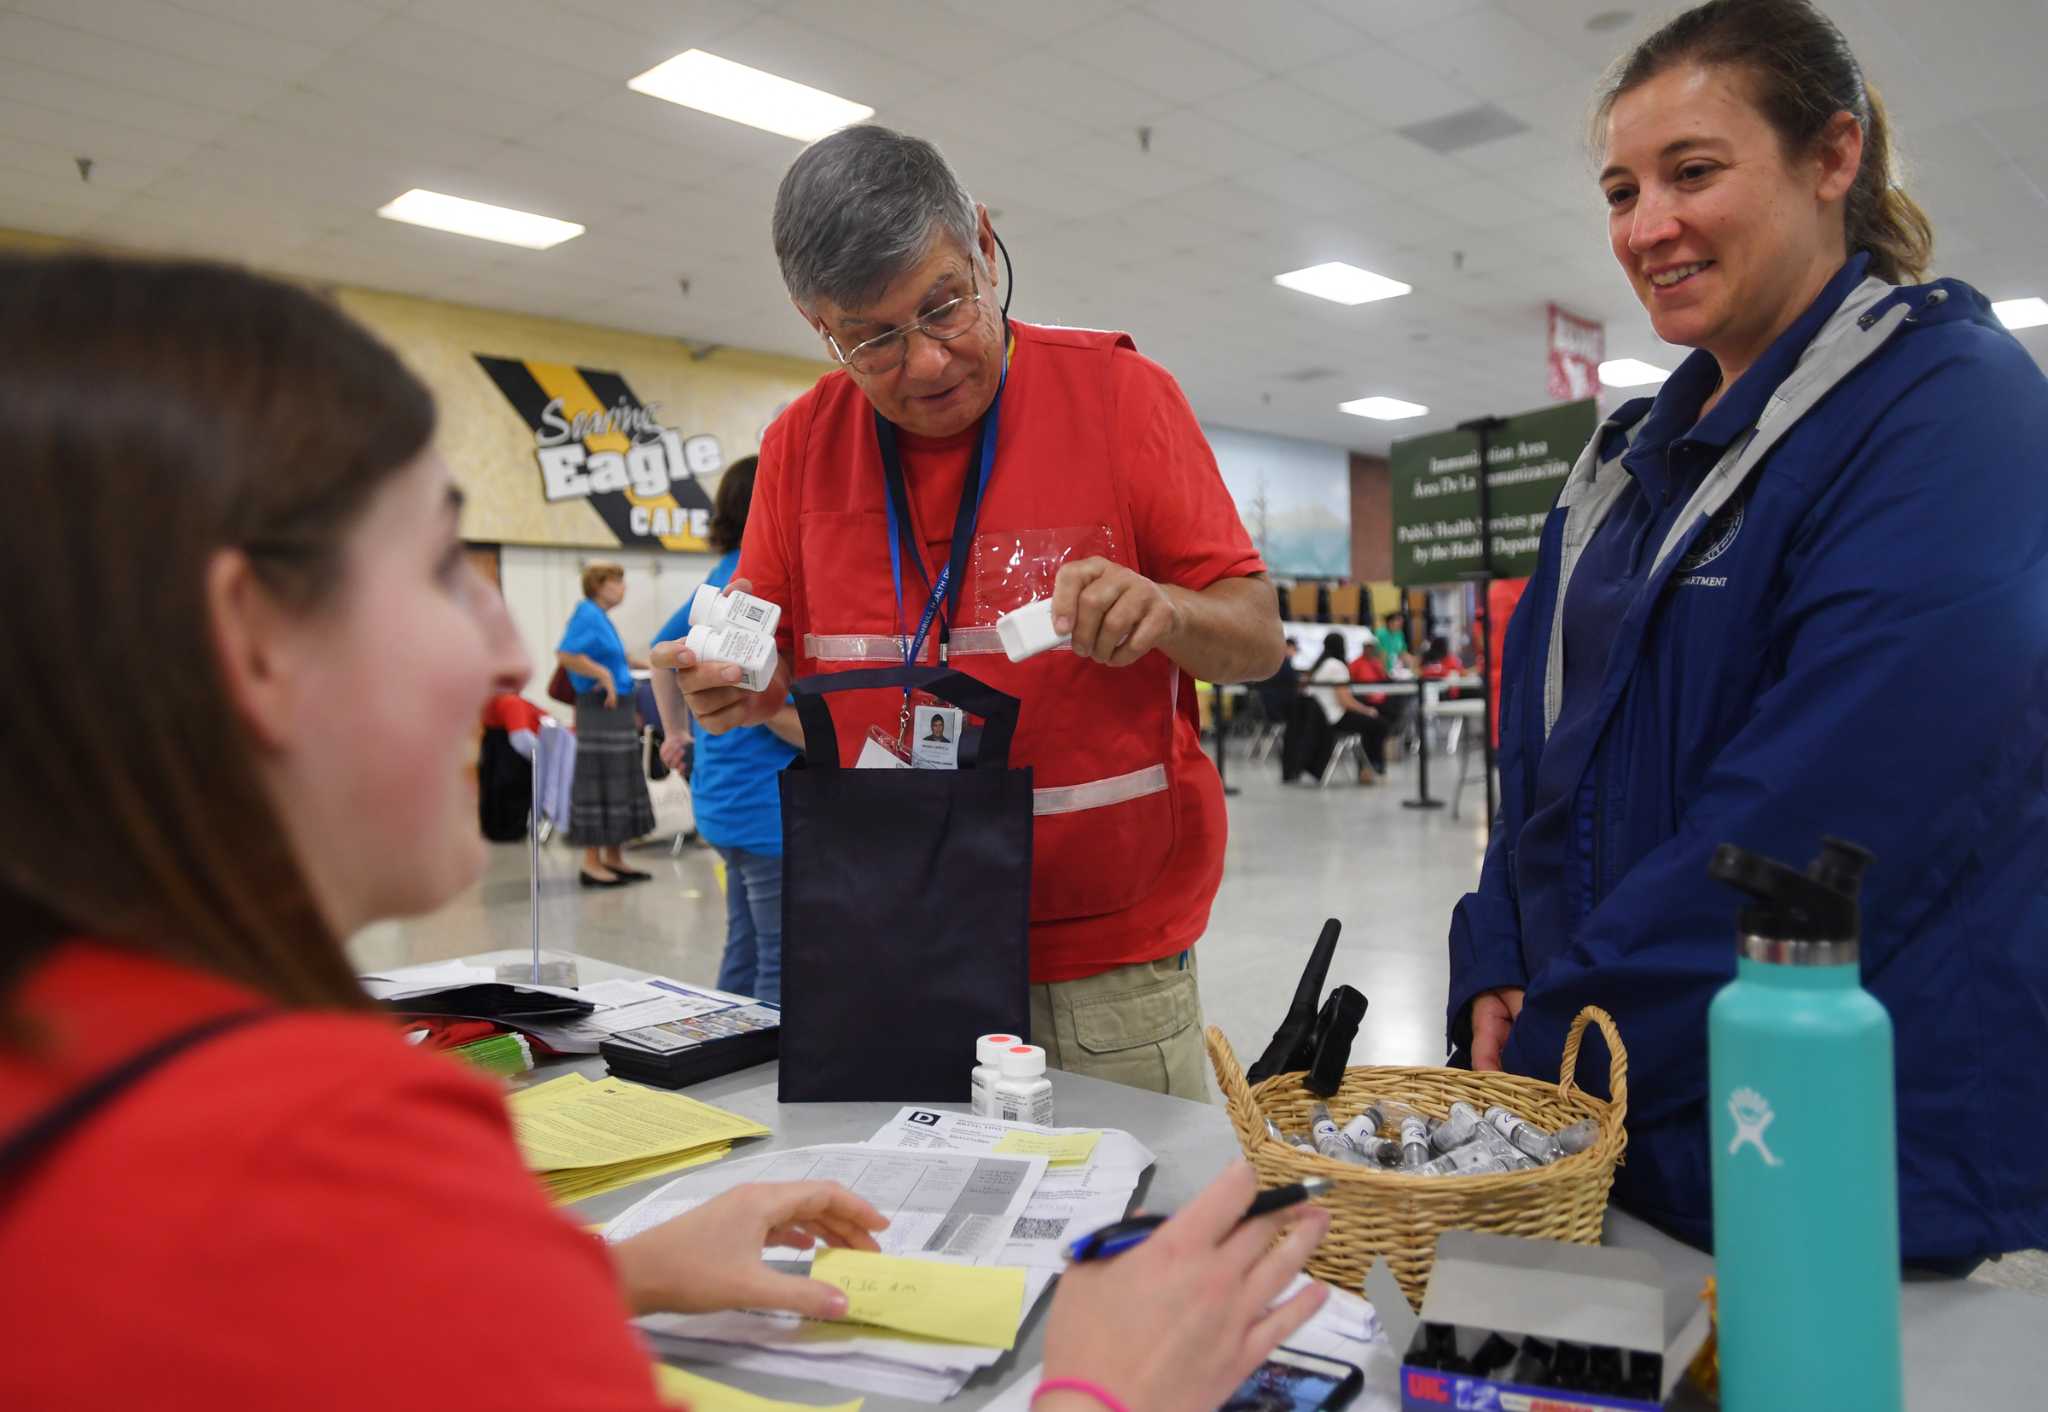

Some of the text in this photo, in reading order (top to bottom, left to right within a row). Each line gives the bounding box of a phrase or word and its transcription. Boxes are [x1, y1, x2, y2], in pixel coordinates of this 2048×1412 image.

[1518, 440, 1548, 457] Area
[537, 427, 722, 500] Eagle
[630, 506, 709, 537] CAFE
[1399, 524, 1434, 544] Public
[1438, 519, 1476, 538] Health
[1413, 545, 1429, 566] by
[1431, 543, 1449, 560] the
